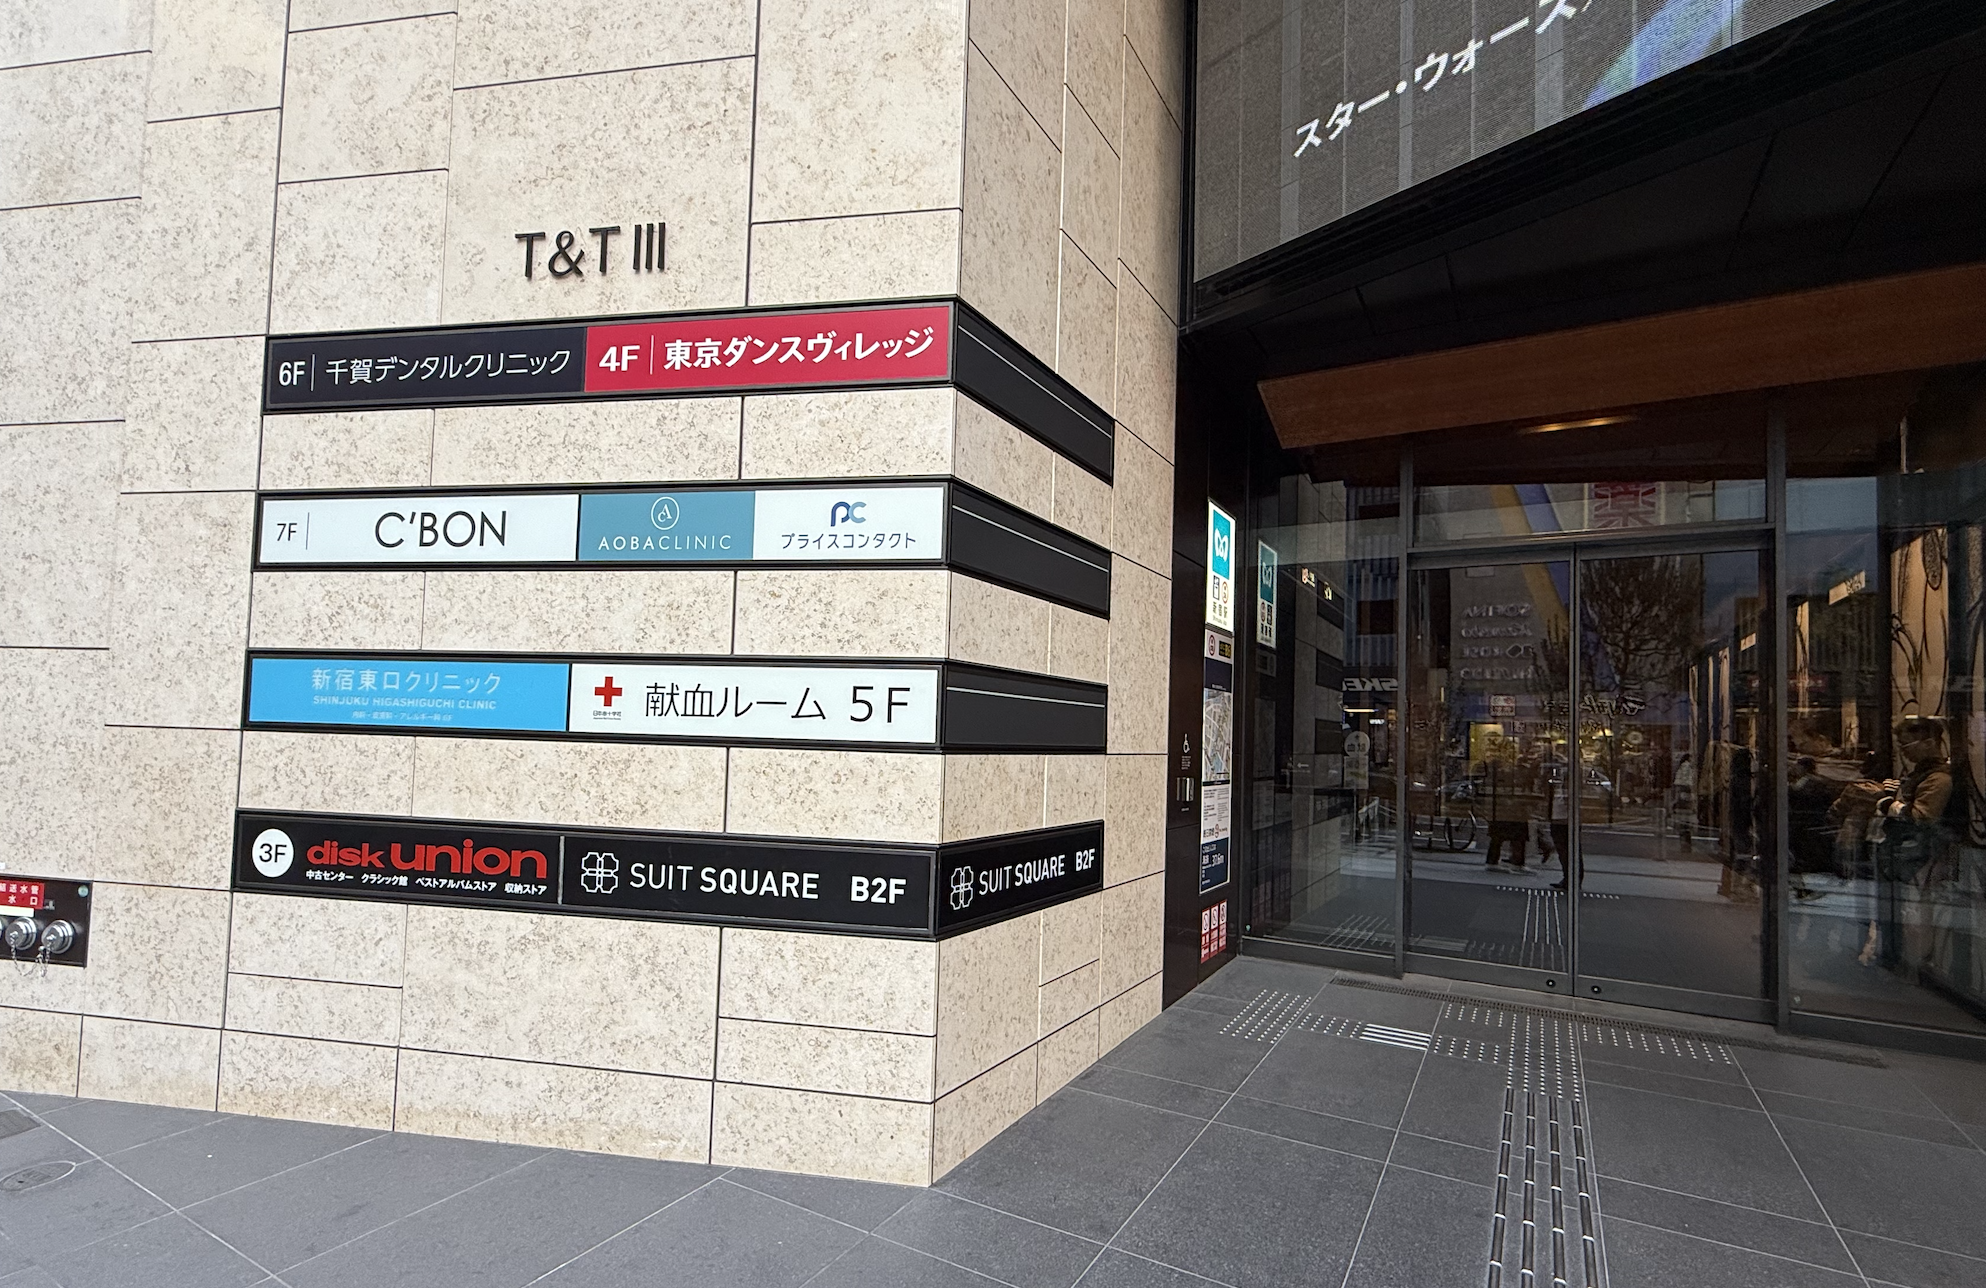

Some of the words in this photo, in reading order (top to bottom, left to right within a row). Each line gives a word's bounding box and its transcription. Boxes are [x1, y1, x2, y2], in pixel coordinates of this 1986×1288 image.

[515, 226, 621, 279] T&T
[598, 345, 641, 372] 4F
[663, 326, 935, 371] 東京ダンスヴィレッジ
[278, 360, 306, 387] 6F
[325, 350, 571, 385] 千賀デンタルクリニック
[276, 522, 298, 542] 7F
[374, 510, 508, 548] C'BON
[781, 532, 917, 550] プライスコンタクト
[311, 667, 501, 695] 新宿東口クリニック
[312, 695, 370, 706] SHINJUKU
[372, 697, 456, 709] HIGASHIGUCHI
[458, 699, 497, 710] CLINIC
[644, 682, 828, 720] 献血ルーム
[258, 843, 288, 863] 3F
[306, 839, 385, 869] disk
[390, 838, 548, 879] union
[978, 865, 1013, 896] SUIT
[1014, 854, 1066, 887] SQUARE
[1075, 848, 1096, 872] B2F
[305, 869, 354, 882] 中古センター
[361, 873, 409, 887] クラシック館
[415, 876, 498, 892] ベストアルバムストア
[504, 882, 548, 896] 収納ストア
[629, 862, 694, 891] SUIT
[700, 866, 820, 900] SQUARE
[850, 874, 907, 904] B2F
